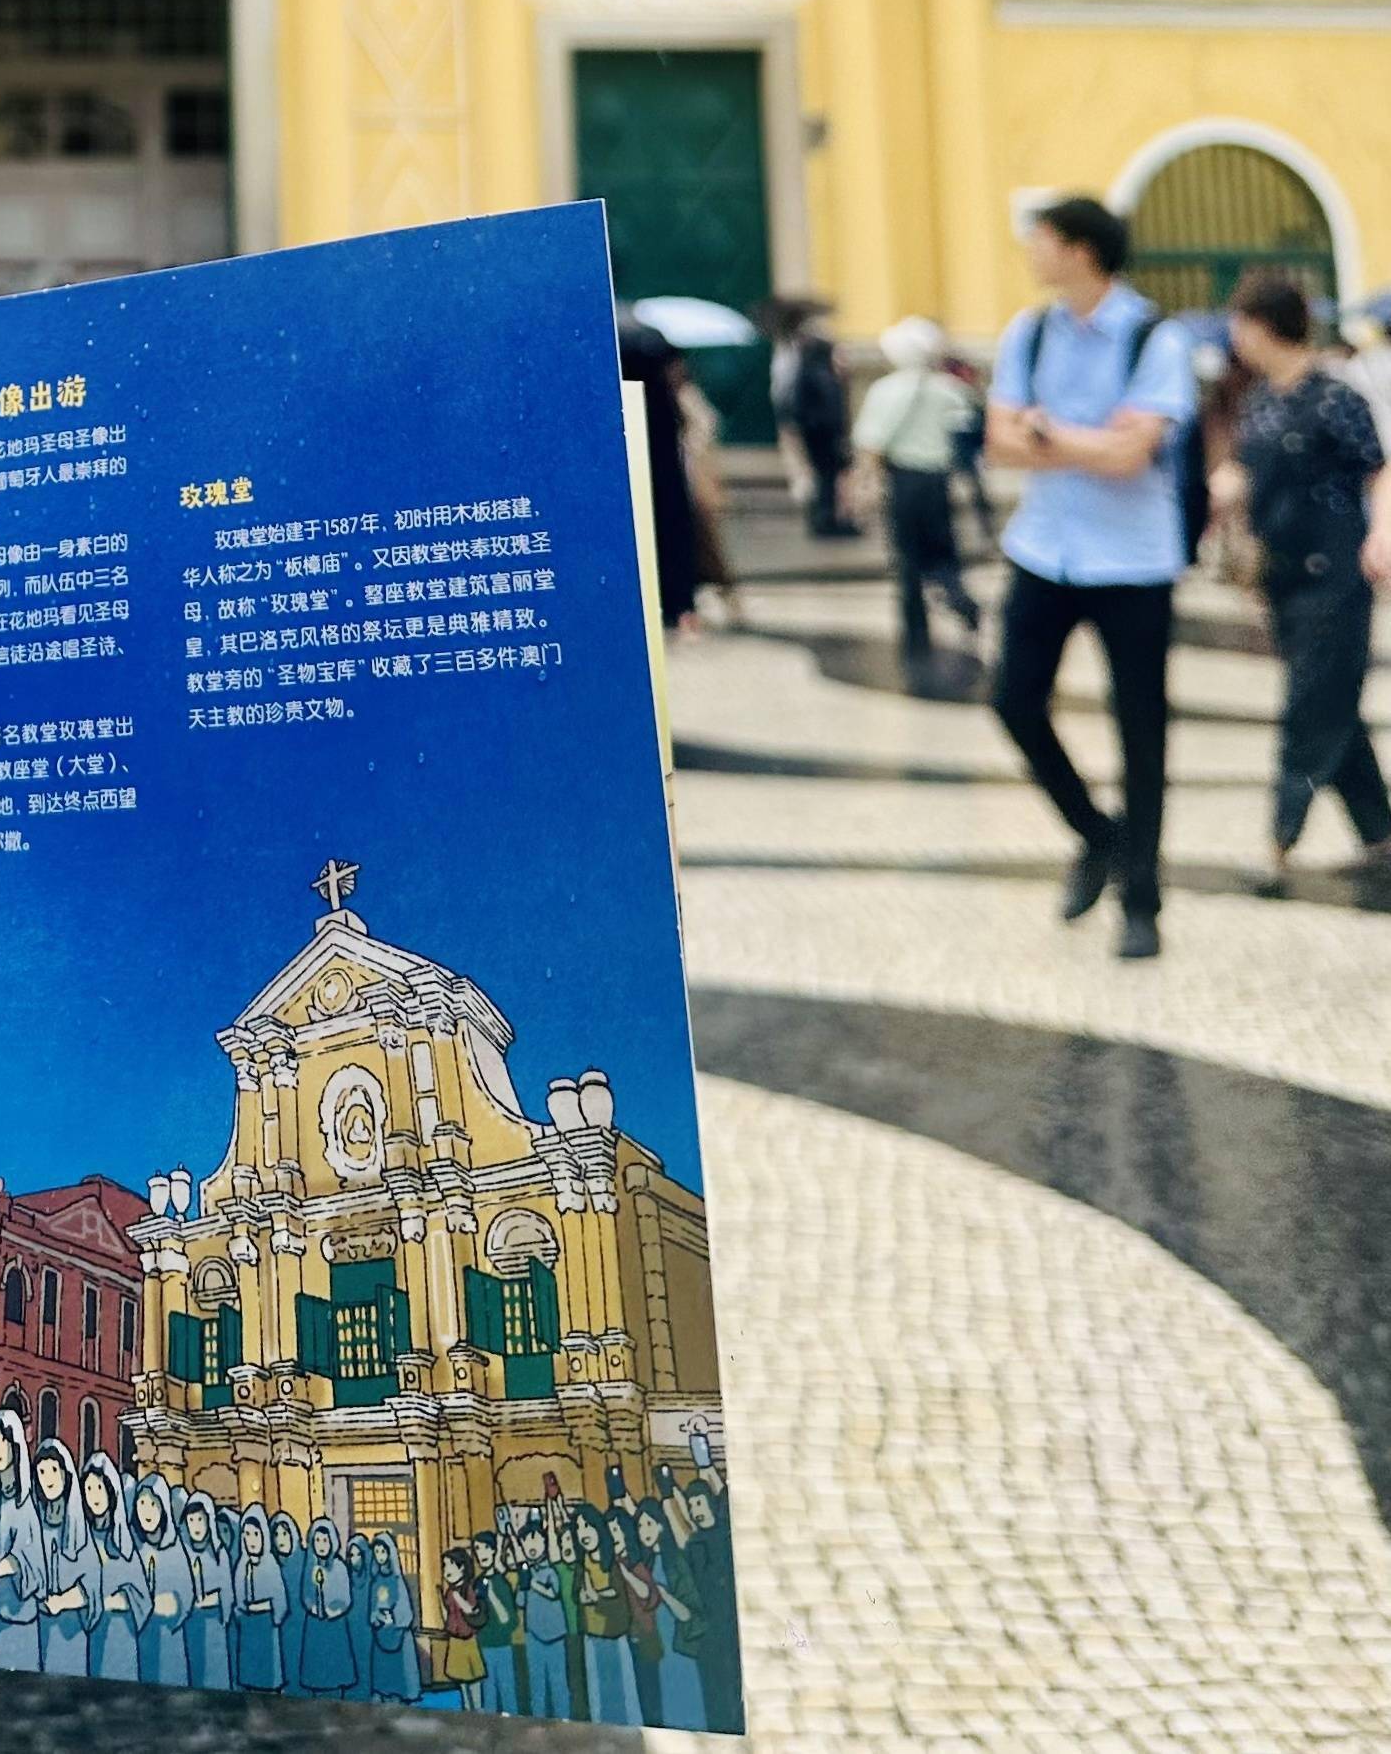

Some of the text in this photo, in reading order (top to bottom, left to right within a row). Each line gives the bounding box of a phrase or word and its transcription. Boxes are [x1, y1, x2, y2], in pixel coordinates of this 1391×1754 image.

[180, 476, 254, 509] 玫瑰堂
[188, 698, 355, 730] 天主教的珍贵文物。
